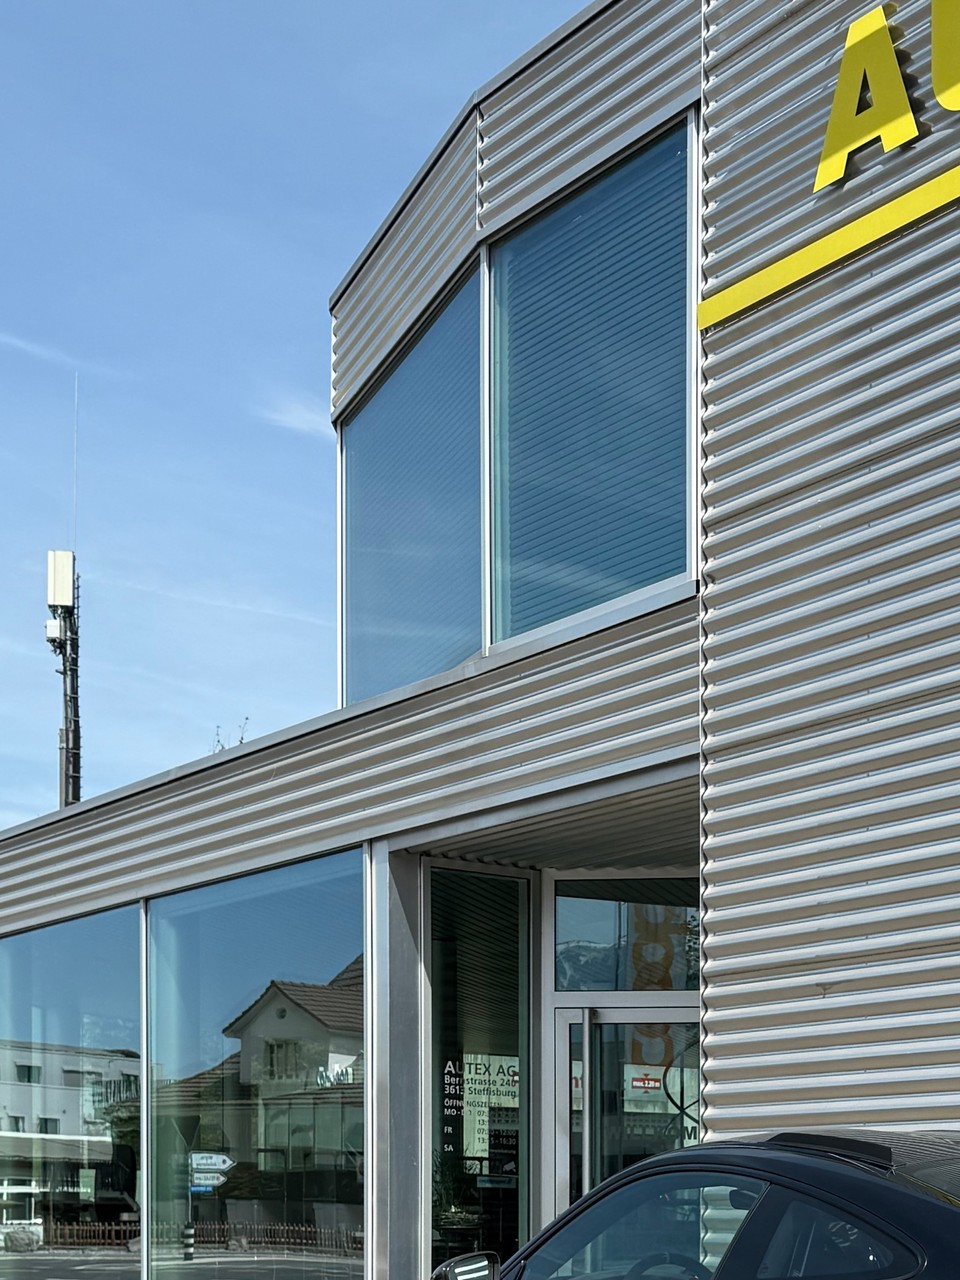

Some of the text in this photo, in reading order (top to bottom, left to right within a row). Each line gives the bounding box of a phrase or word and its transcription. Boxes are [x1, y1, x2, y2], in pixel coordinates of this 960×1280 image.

[496, 1064, 517, 1077] AG
[468, 1086, 517, 1099] Steffisburg
[444, 1126, 453, 1134] FR
[444, 1144, 453, 1152] SA
